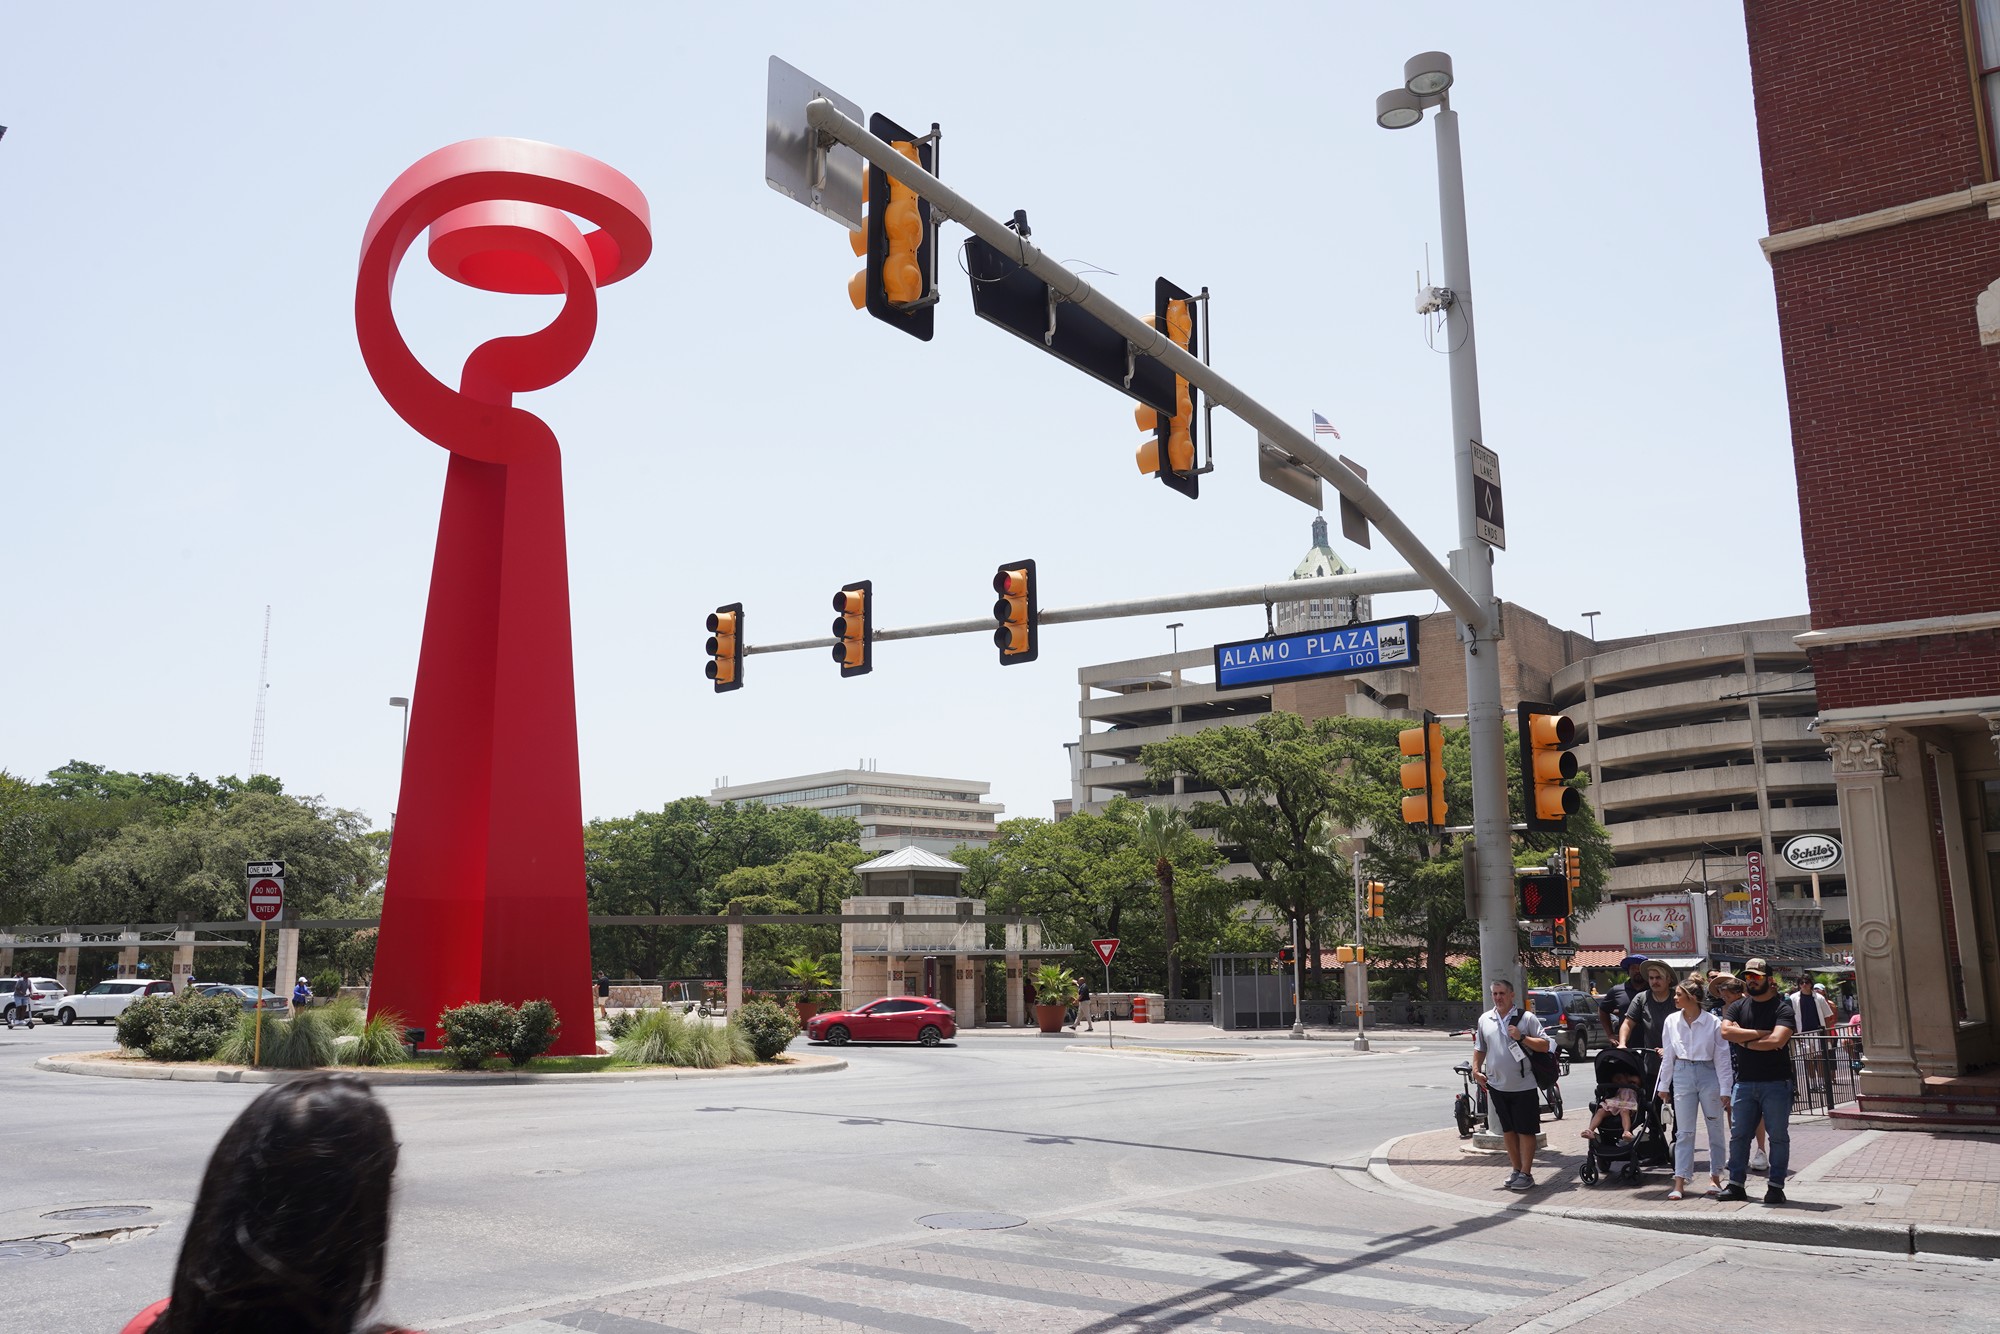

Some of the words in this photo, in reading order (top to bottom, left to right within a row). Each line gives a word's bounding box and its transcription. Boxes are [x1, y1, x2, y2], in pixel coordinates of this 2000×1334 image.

[1473, 446, 1496, 469] RESTRICTED
[1480, 463, 1493, 480] LANE
[1484, 524, 1498, 541] ENDS
[1223, 642, 1290, 667] ALAMO
[1307, 630, 1374, 655] PLAZA
[1349, 651, 1374, 667] 100
[1790, 844, 1834, 861] Schilo's
[1749, 855, 1761, 891] CASA
[256, 905, 275, 913] ENTER
[1633, 908, 1661, 922] Casa
[1664, 908, 1687, 922] Rio
[1752, 897, 1764, 924] RIO
[1716, 926, 1744, 937] Mexican
[1745, 926, 1764, 937] food
[1633, 942, 1666, 950] MEXICAN
[1670, 941, 1692, 949] FOOD
